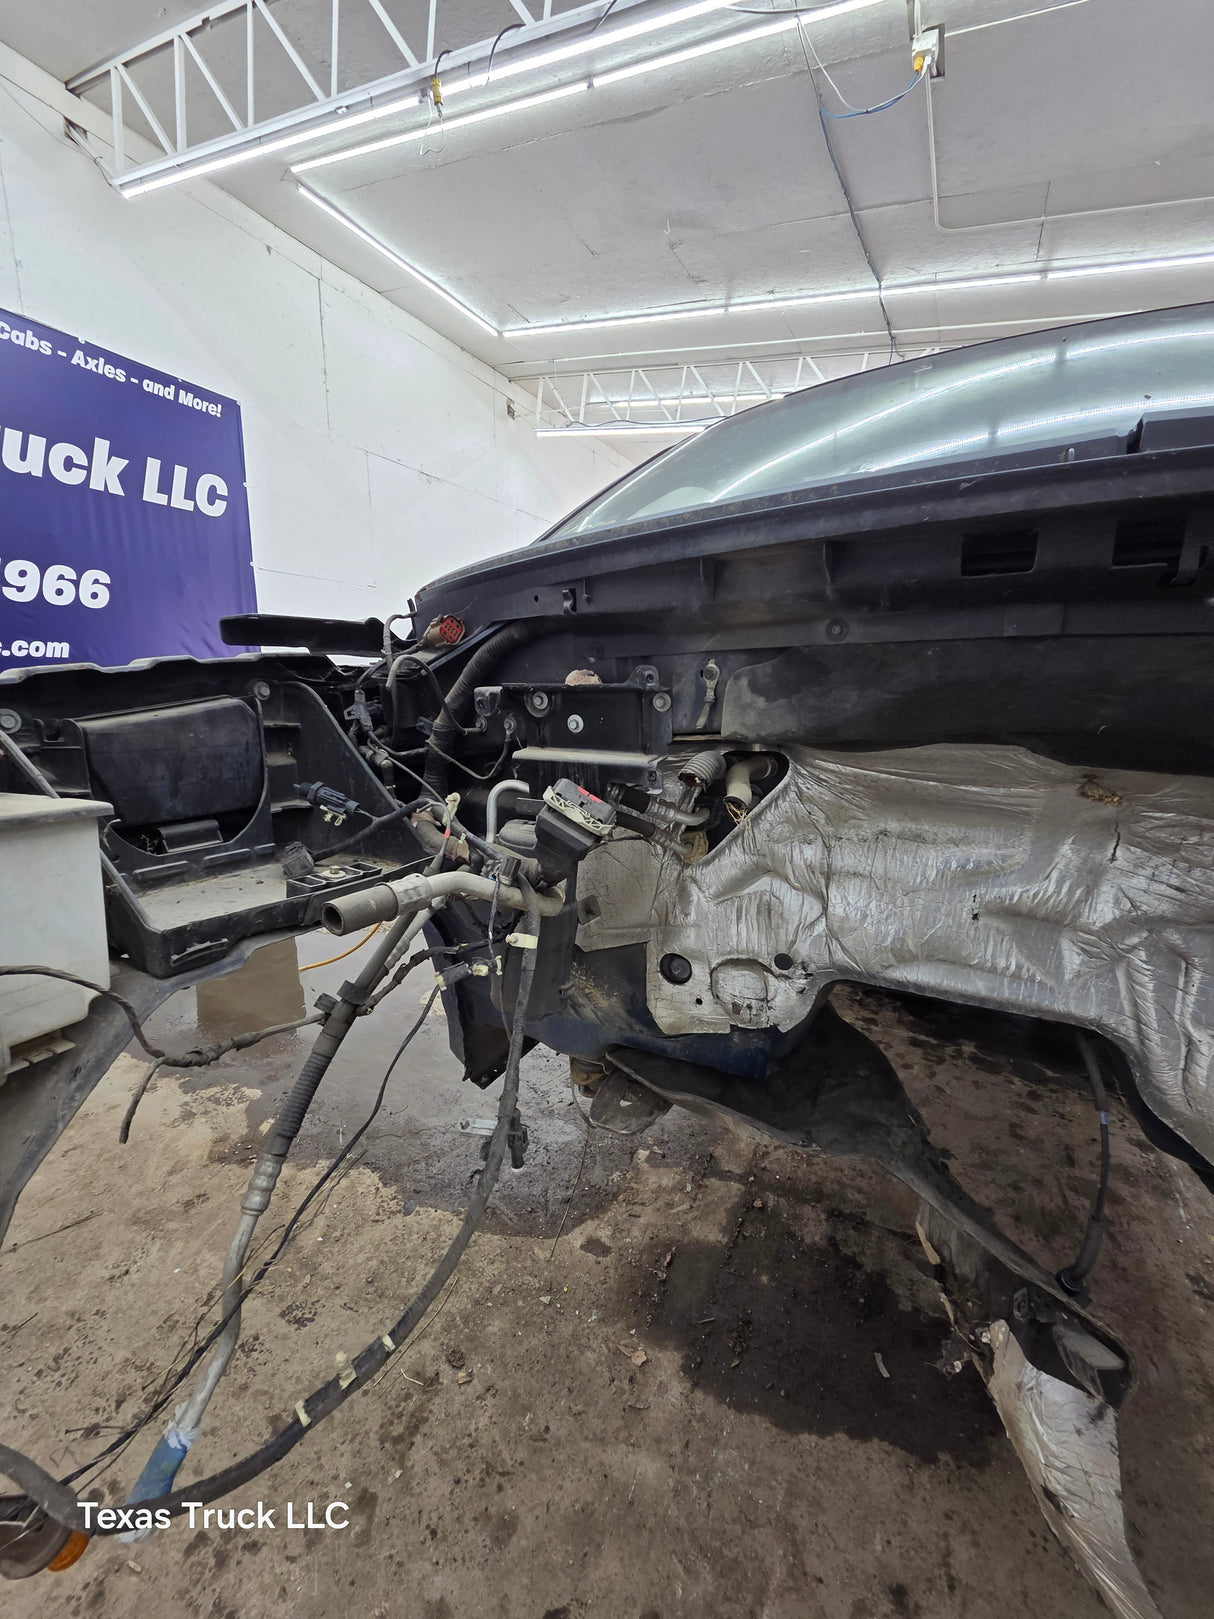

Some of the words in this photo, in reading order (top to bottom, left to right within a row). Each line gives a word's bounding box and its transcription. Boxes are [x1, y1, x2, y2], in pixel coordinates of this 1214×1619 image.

[0, 321, 52, 355] Cabs
[71, 350, 126, 382] Axles
[142, 379, 175, 400] and
[178, 389, 222, 417] More!
[0, 425, 129, 496] uck
[143, 457, 228, 517] LLC
[0, 557, 111, 609] 966
[0, 640, 70, 658] .com
